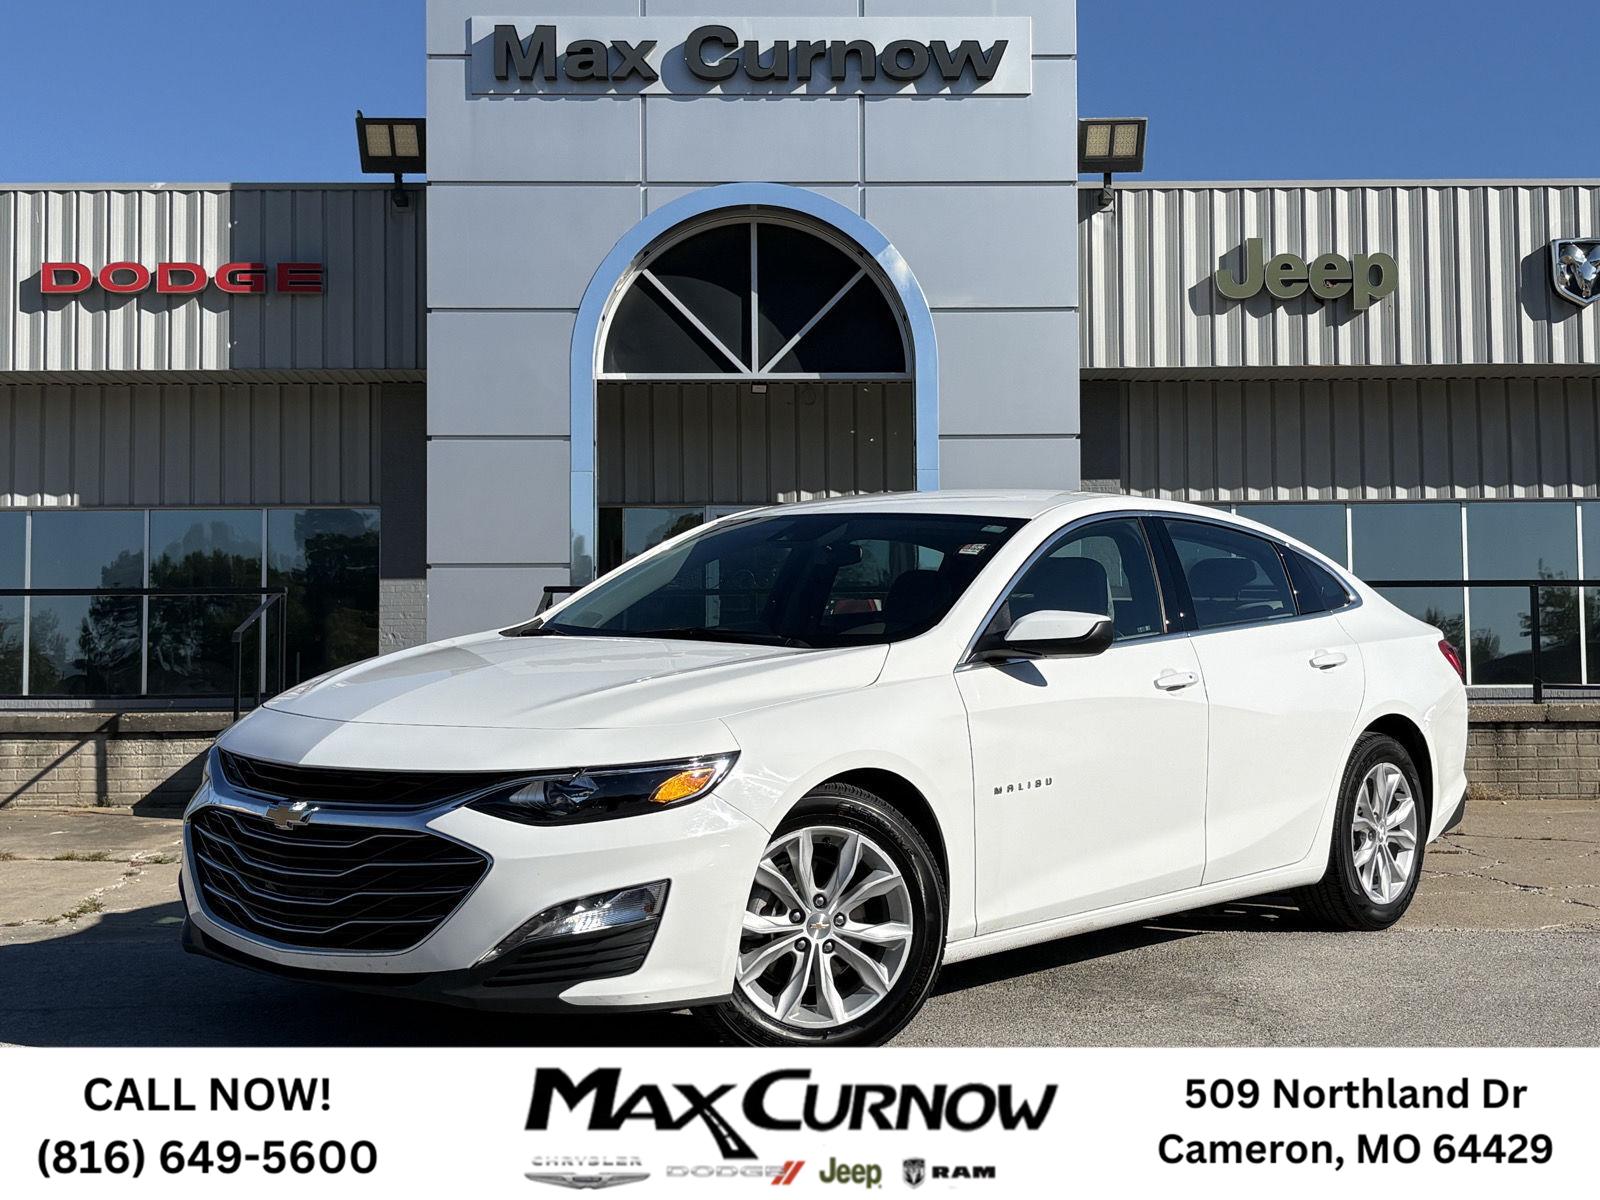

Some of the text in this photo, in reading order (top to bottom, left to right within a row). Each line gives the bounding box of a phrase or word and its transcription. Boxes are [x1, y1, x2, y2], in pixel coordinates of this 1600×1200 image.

[494, 25, 1009, 82] Max Curnow
[40, 262, 323, 294] DODGE
[1215, 238, 1399, 310] Jeep
[993, 777, 1053, 795] MALIBU
